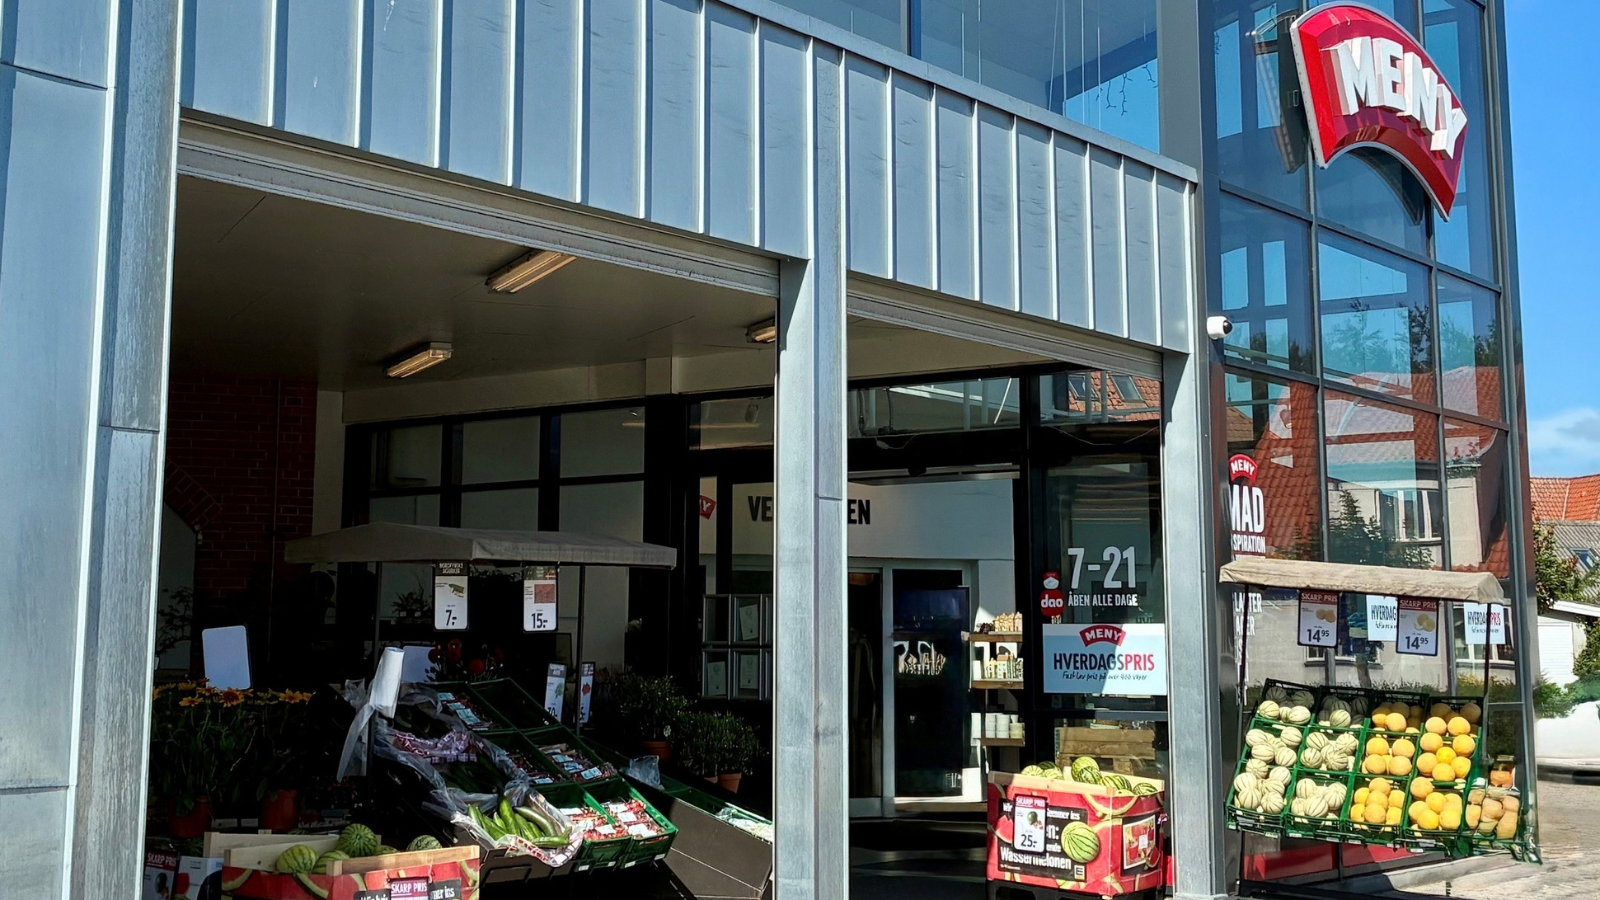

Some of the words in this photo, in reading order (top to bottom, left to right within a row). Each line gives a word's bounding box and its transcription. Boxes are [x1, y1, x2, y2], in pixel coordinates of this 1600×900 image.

[1330, 36, 1467, 159] MENY
[1231, 459, 1255, 475] MENY
[1068, 546, 1136, 588] 7-21
[1041, 594, 1063, 608] dao
[1068, 591, 1090, 606] ÅBEN
[1092, 594, 1113, 606] ALLE
[1115, 594, 1138, 607] DAGE
[1301, 593, 1322, 601] SKARP
[1323, 594, 1338, 602] PRIS
[1399, 599, 1422, 607] SKARP
[1422, 601, 1437, 609] PRIS
[1085, 628, 1121, 641] MENY
[1053, 653, 1155, 671] HVERDAGSPRIS
[1000, 846, 1072, 870] Wassermelonen
[391, 883, 412, 894] SKARP
[413, 882, 427, 893] PRIS
